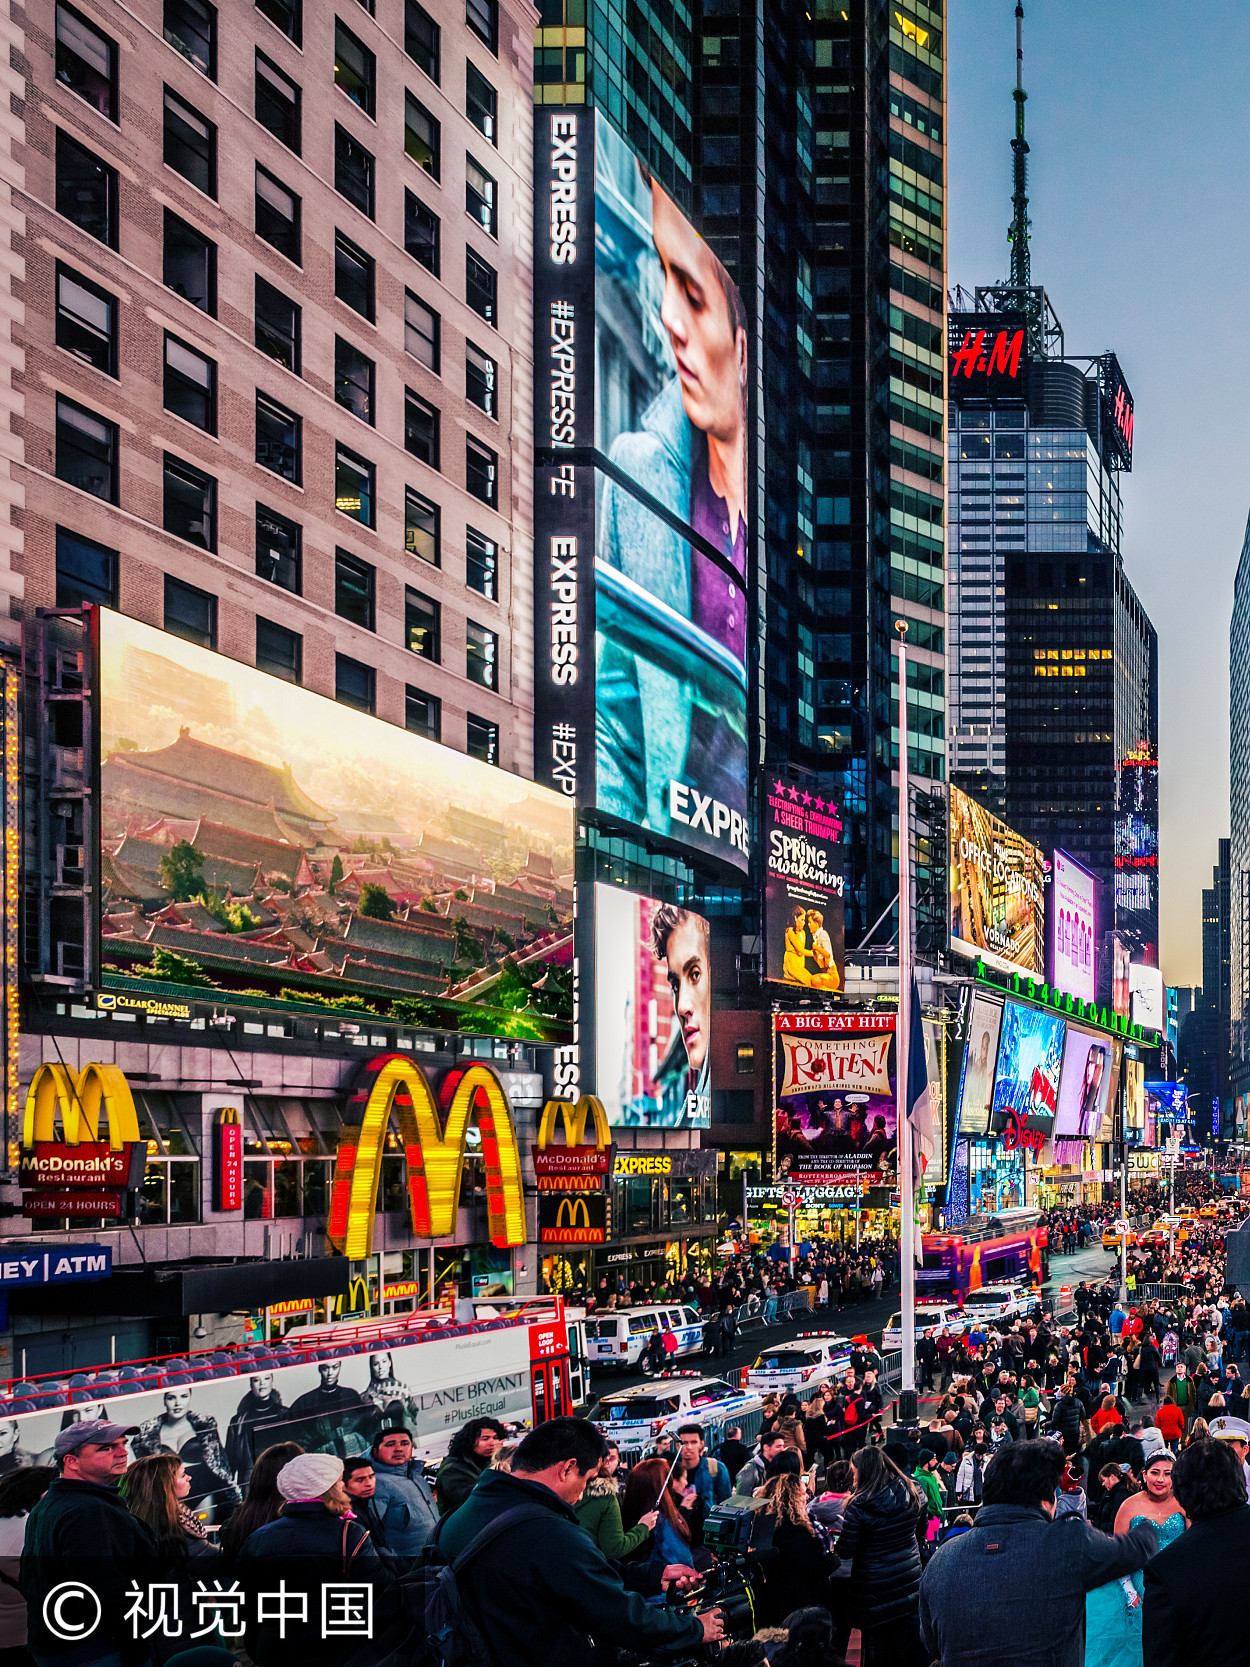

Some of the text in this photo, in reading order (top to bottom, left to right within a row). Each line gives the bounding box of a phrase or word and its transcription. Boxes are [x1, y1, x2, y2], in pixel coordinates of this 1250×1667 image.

[551, 113, 577, 265] EXPRESS
[952, 330, 1024, 379] H&M
[1114, 384, 1134, 450] H&M
[550, 536, 577, 686] EXPRESS
[774, 809, 803, 831] A SHEER
[770, 830, 828, 869] SPRING
[768, 855, 845, 897] awakening
[960, 837, 992, 874] OFFICE
[993, 858, 1039, 903] LOCATIONS
[983, 925, 1020, 954] VORNADO
[1013, 972, 1144, 1040] 1540 BROADWAY
[795, 1016, 823, 1028] BIG,
[828, 1016, 854, 1028] FAT
[797, 1040, 876, 1051] SOMETHING
[228, 1129, 236, 1158] OPEN
[22, 1157, 124, 1172] McDonald's
[537, 1154, 606, 1165] McDonald's
[613, 1156, 672, 1174] EXPRESS
[38, 1173, 106, 1182] Restaurant
[228, 1169, 236, 1206] HOURS
[746, 1186, 784, 1198] GIFTS
[24, 1201, 116, 1210] OPEN 24 HOURS
[0, 1255, 106, 1279] EY ATM
[608, 1253, 632, 1262] EXPRESS
[538, 1332, 554, 1340] OPEN
[538, 1339, 554, 1347] LOOP
[419, 1372, 525, 1412] LANE BRYANT
[444, 1397, 506, 1424] #PlusIsEqual
